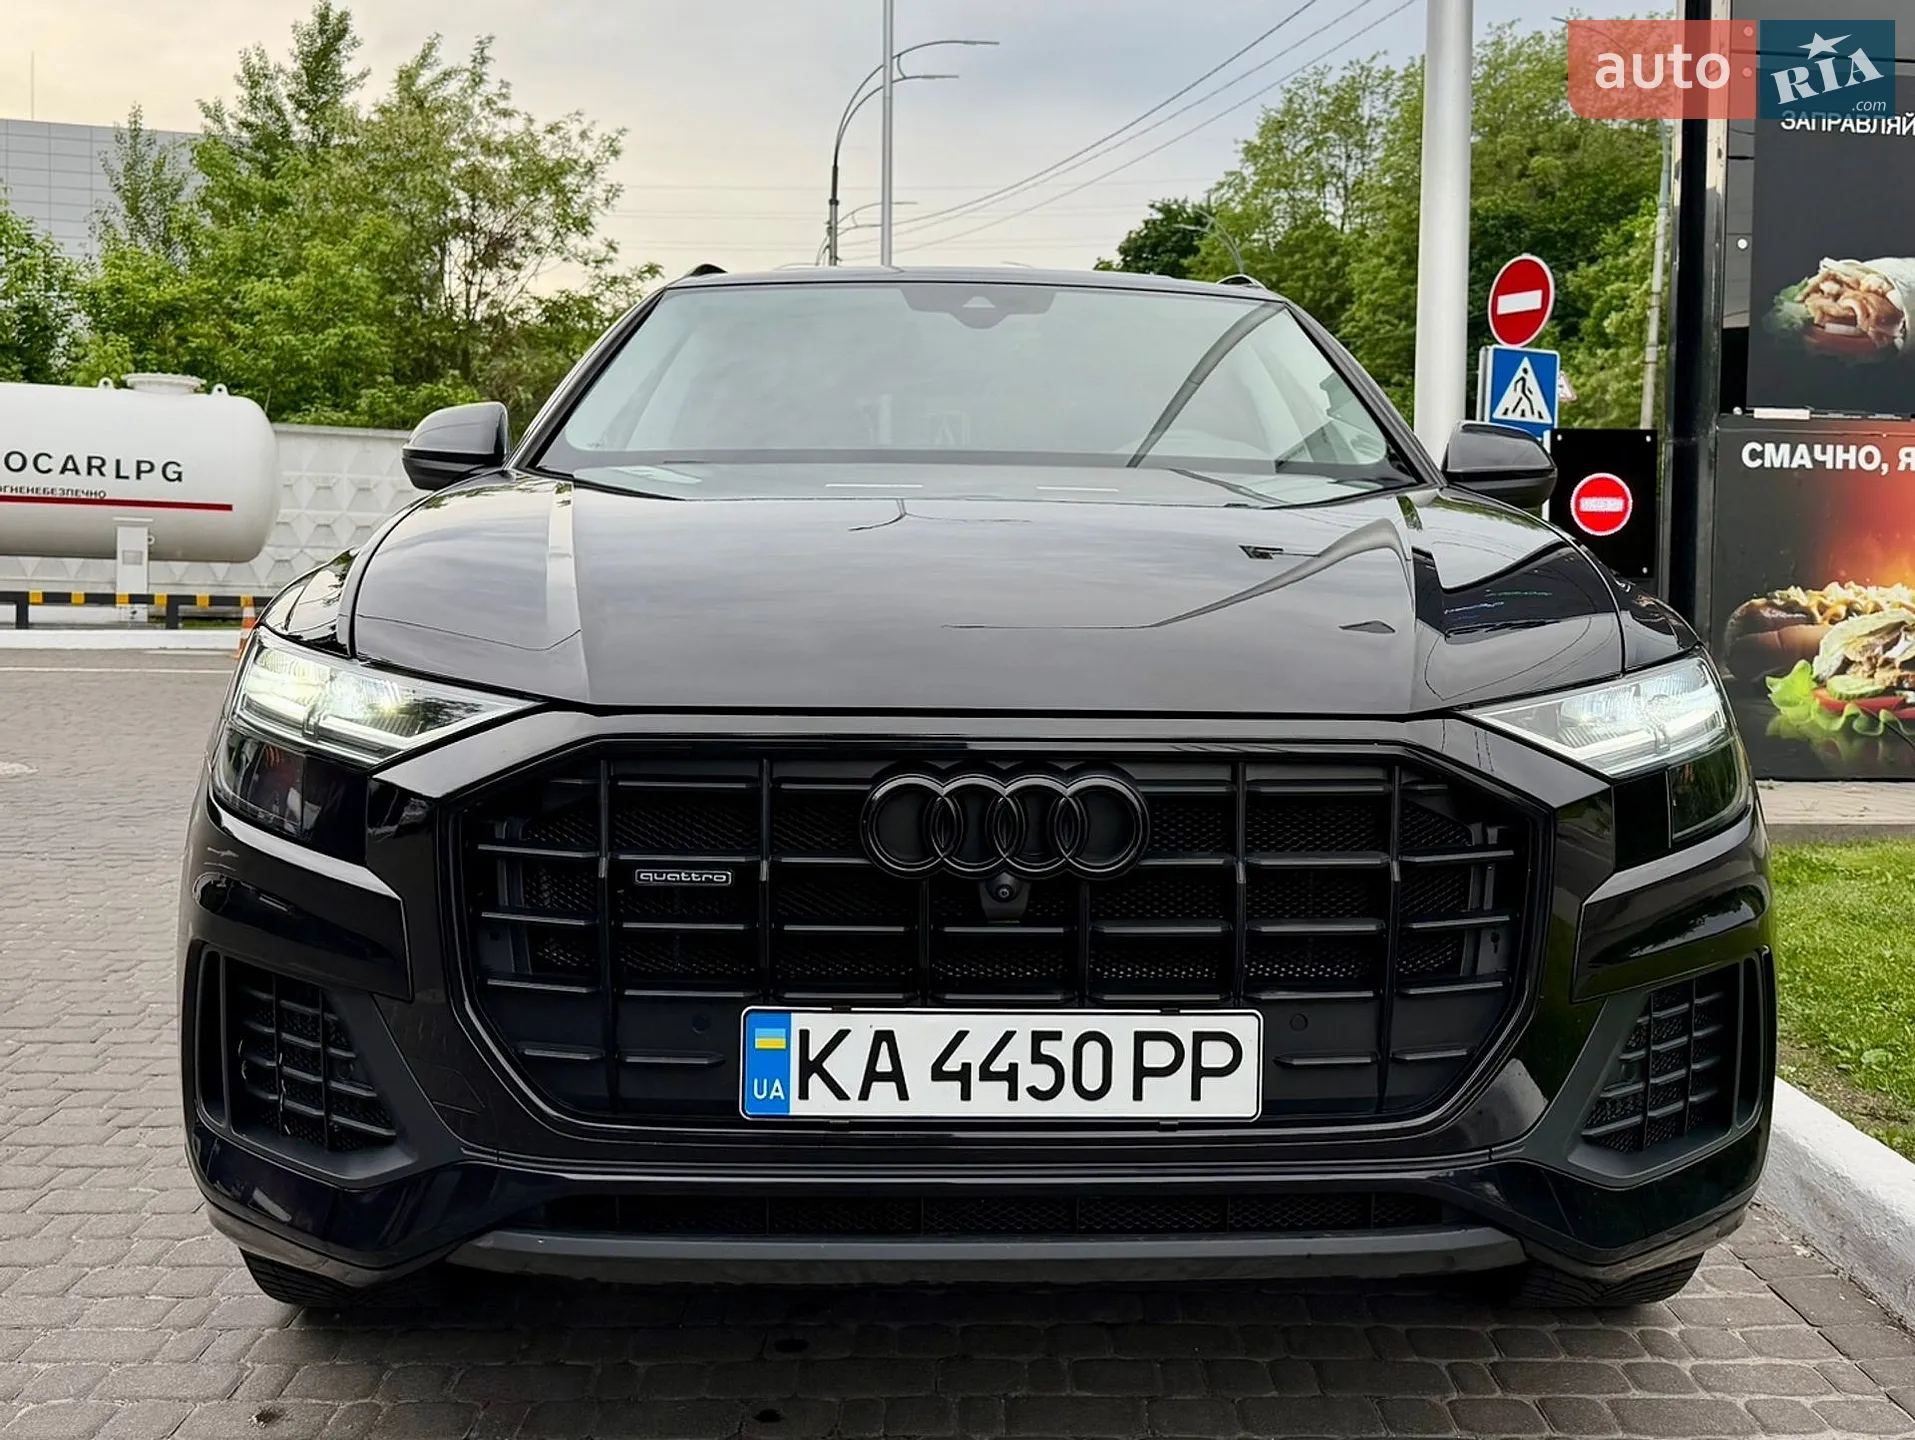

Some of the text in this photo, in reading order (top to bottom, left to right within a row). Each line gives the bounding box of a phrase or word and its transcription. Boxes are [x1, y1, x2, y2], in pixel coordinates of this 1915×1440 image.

[1741, 441, 1889, 476] СМАЧНО,
[639, 872, 727, 882] quattro
[798, 1029, 1244, 1102] KA 4450 PP
[753, 1078, 786, 1100] UA
